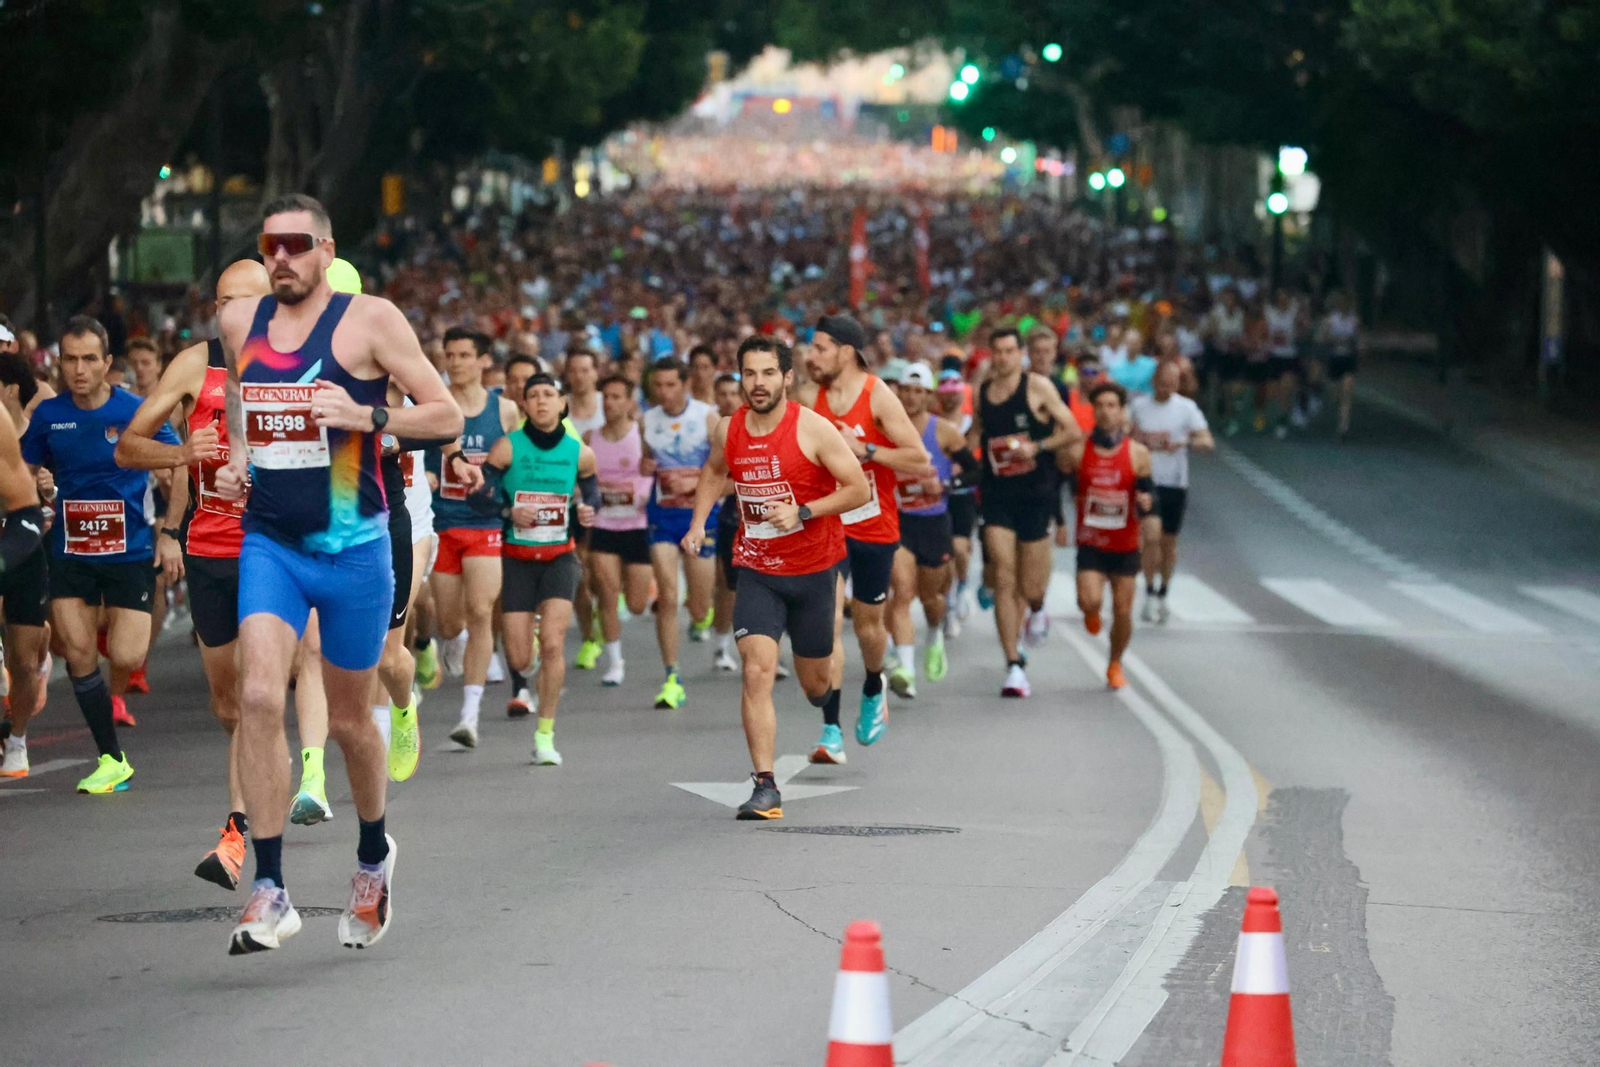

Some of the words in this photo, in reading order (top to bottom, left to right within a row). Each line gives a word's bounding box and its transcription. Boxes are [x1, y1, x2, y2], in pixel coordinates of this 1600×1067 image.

[51, 422, 77, 430] macron
[256, 415, 306, 431] 13598
[748, 485, 786, 496] GENERALI
[80, 504, 119, 512] GENERALI
[80, 520, 108, 531] 2412
